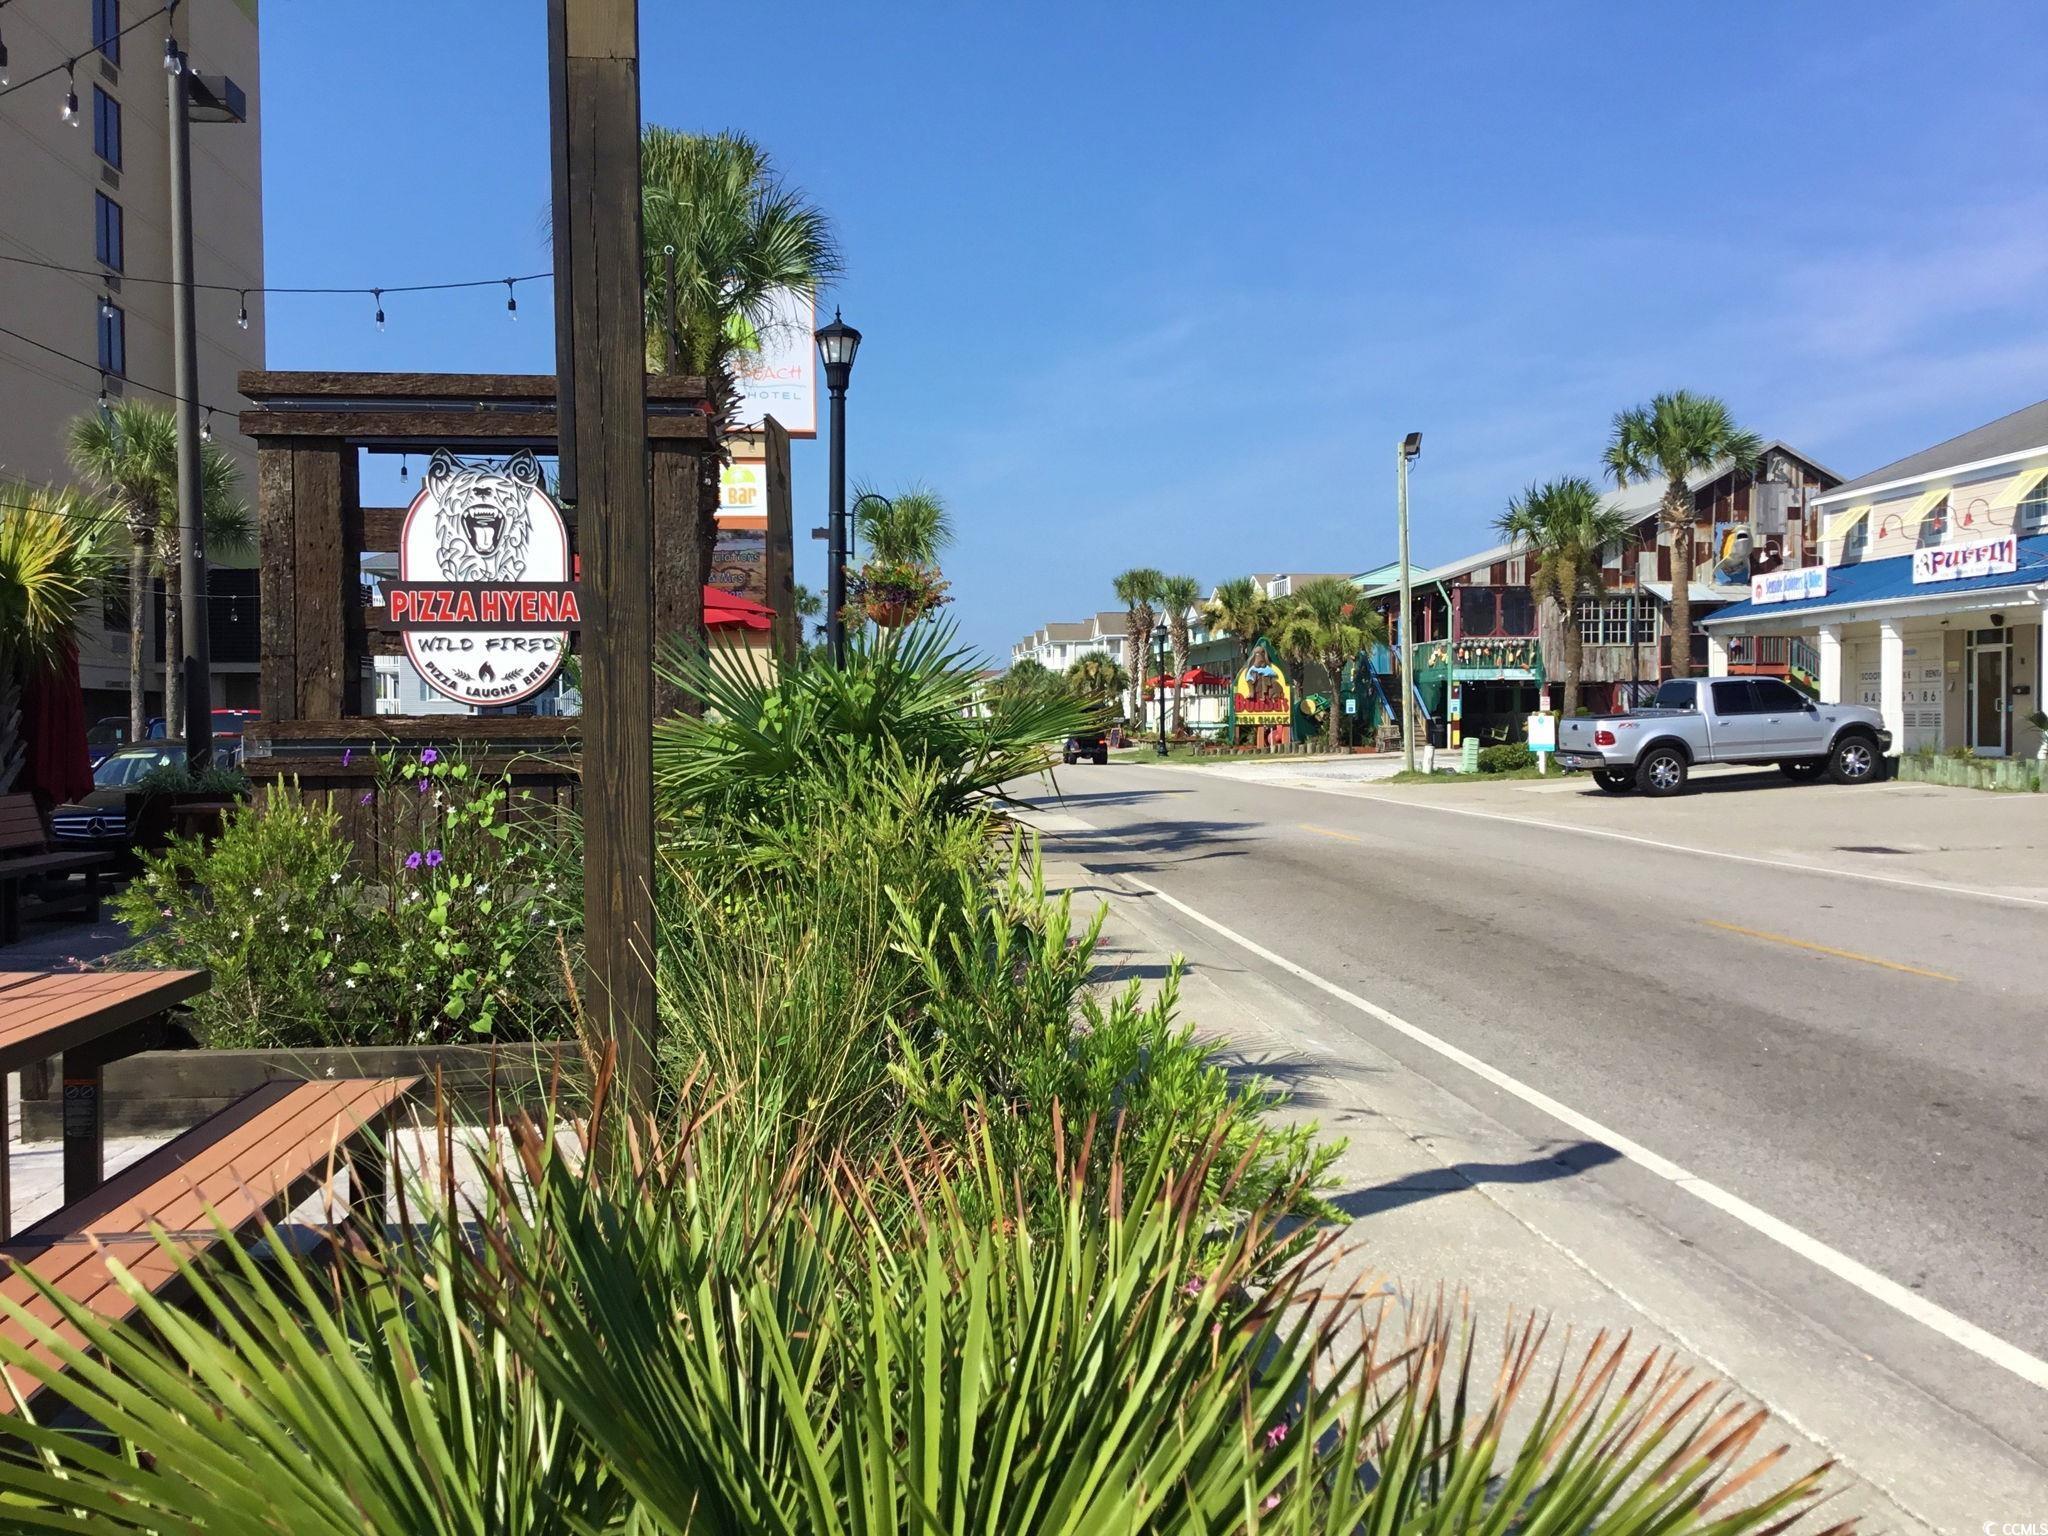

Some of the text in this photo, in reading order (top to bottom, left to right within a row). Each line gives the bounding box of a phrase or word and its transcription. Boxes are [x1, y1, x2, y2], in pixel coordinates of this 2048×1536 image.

[747, 391, 802, 400] HOTEL
[1931, 539, 2014, 575] PUFFIN
[390, 590, 581, 622] PIZZA HYENA
[418, 636, 557, 653] WILD FIRED
[424, 660, 549, 698] PIZZA LAUGHS BEER
[1257, 716, 1290, 724] SHACK
